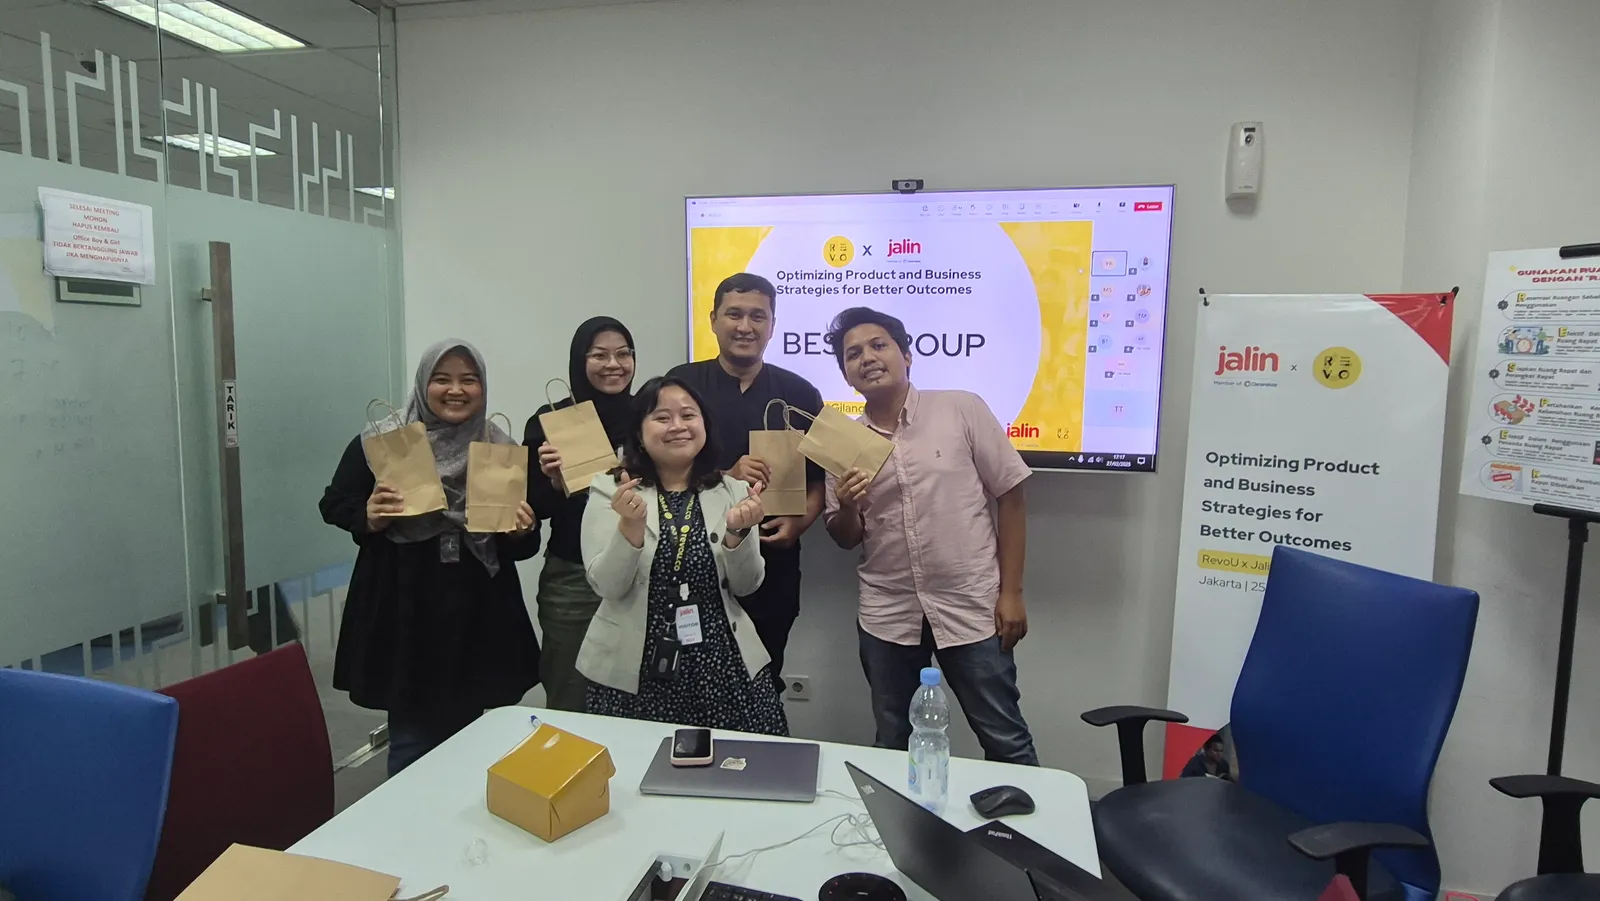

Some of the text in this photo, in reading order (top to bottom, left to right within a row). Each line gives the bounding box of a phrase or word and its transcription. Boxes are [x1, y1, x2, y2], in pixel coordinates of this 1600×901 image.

[69, 203, 120, 216] SELESAI MEETING
[83, 214, 108, 223] MOHON
[72, 222, 120, 234] HAPUS KEMBALI
[72, 234, 91, 242] Office
[73, 244, 118, 254] BERTANGGUNG
[119, 249, 139, 257] JAWAB
[887, 239, 921, 257] jalin
[66, 251, 129, 263] JIKA MENGHAPUSNYA
[776, 269, 982, 283] Optimizing Product and Business
[1517, 267, 1577, 276] GUNAKAN
[1532, 275, 1583, 283] DENGAN
[776, 284, 973, 297] Strategies for Better Outcomes
[783, 332, 986, 357] BES OUP
[1214, 345, 1279, 376] jalin
[226, 386, 236, 430] TARIK
[1006, 423, 1040, 439] jalin
[1205, 451, 1380, 475] Optimizing Product
[1203, 477, 1316, 496] and Business
[1201, 500, 1324, 523] Strategies for
[1200, 524, 1352, 552] Better Outcomes
[1202, 554, 1239, 568] RevoU
[1250, 559, 1270, 571] Jali
[1198, 575, 1242, 590] Jakarta
